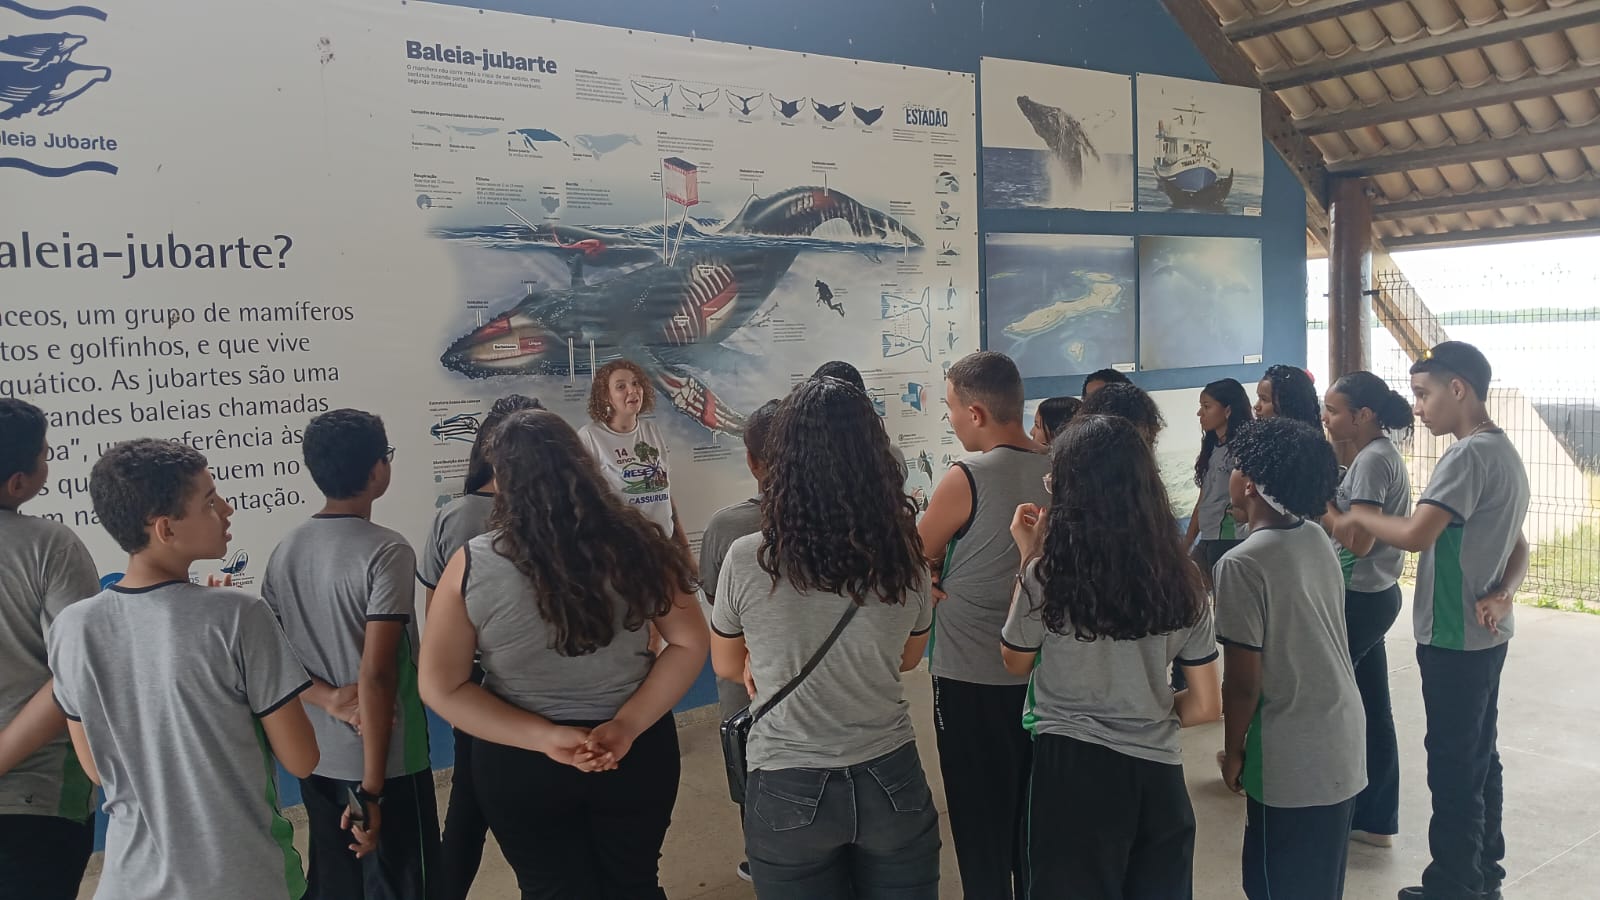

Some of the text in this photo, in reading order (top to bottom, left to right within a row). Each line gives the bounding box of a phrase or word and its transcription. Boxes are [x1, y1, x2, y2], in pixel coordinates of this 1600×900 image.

[406, 40, 558, 74] Baleia-jubarte
[906, 107, 948, 127] ESTADÃO
[44, 133, 118, 151] Jubarte
[0, 301, 354, 330] ceos, um grupo de mamíferos
[0, 332, 311, 365] tos e golfinhos, e que vive
[0, 365, 339, 399] quático. As jubartes são uma
[130, 399, 211, 422] baleias
[219, 393, 329, 417] chamadas
[164, 425, 304, 451] ferência às
[615, 448, 628, 459] 14
[58, 477, 89, 499] qu
[274, 460, 300, 476] no
